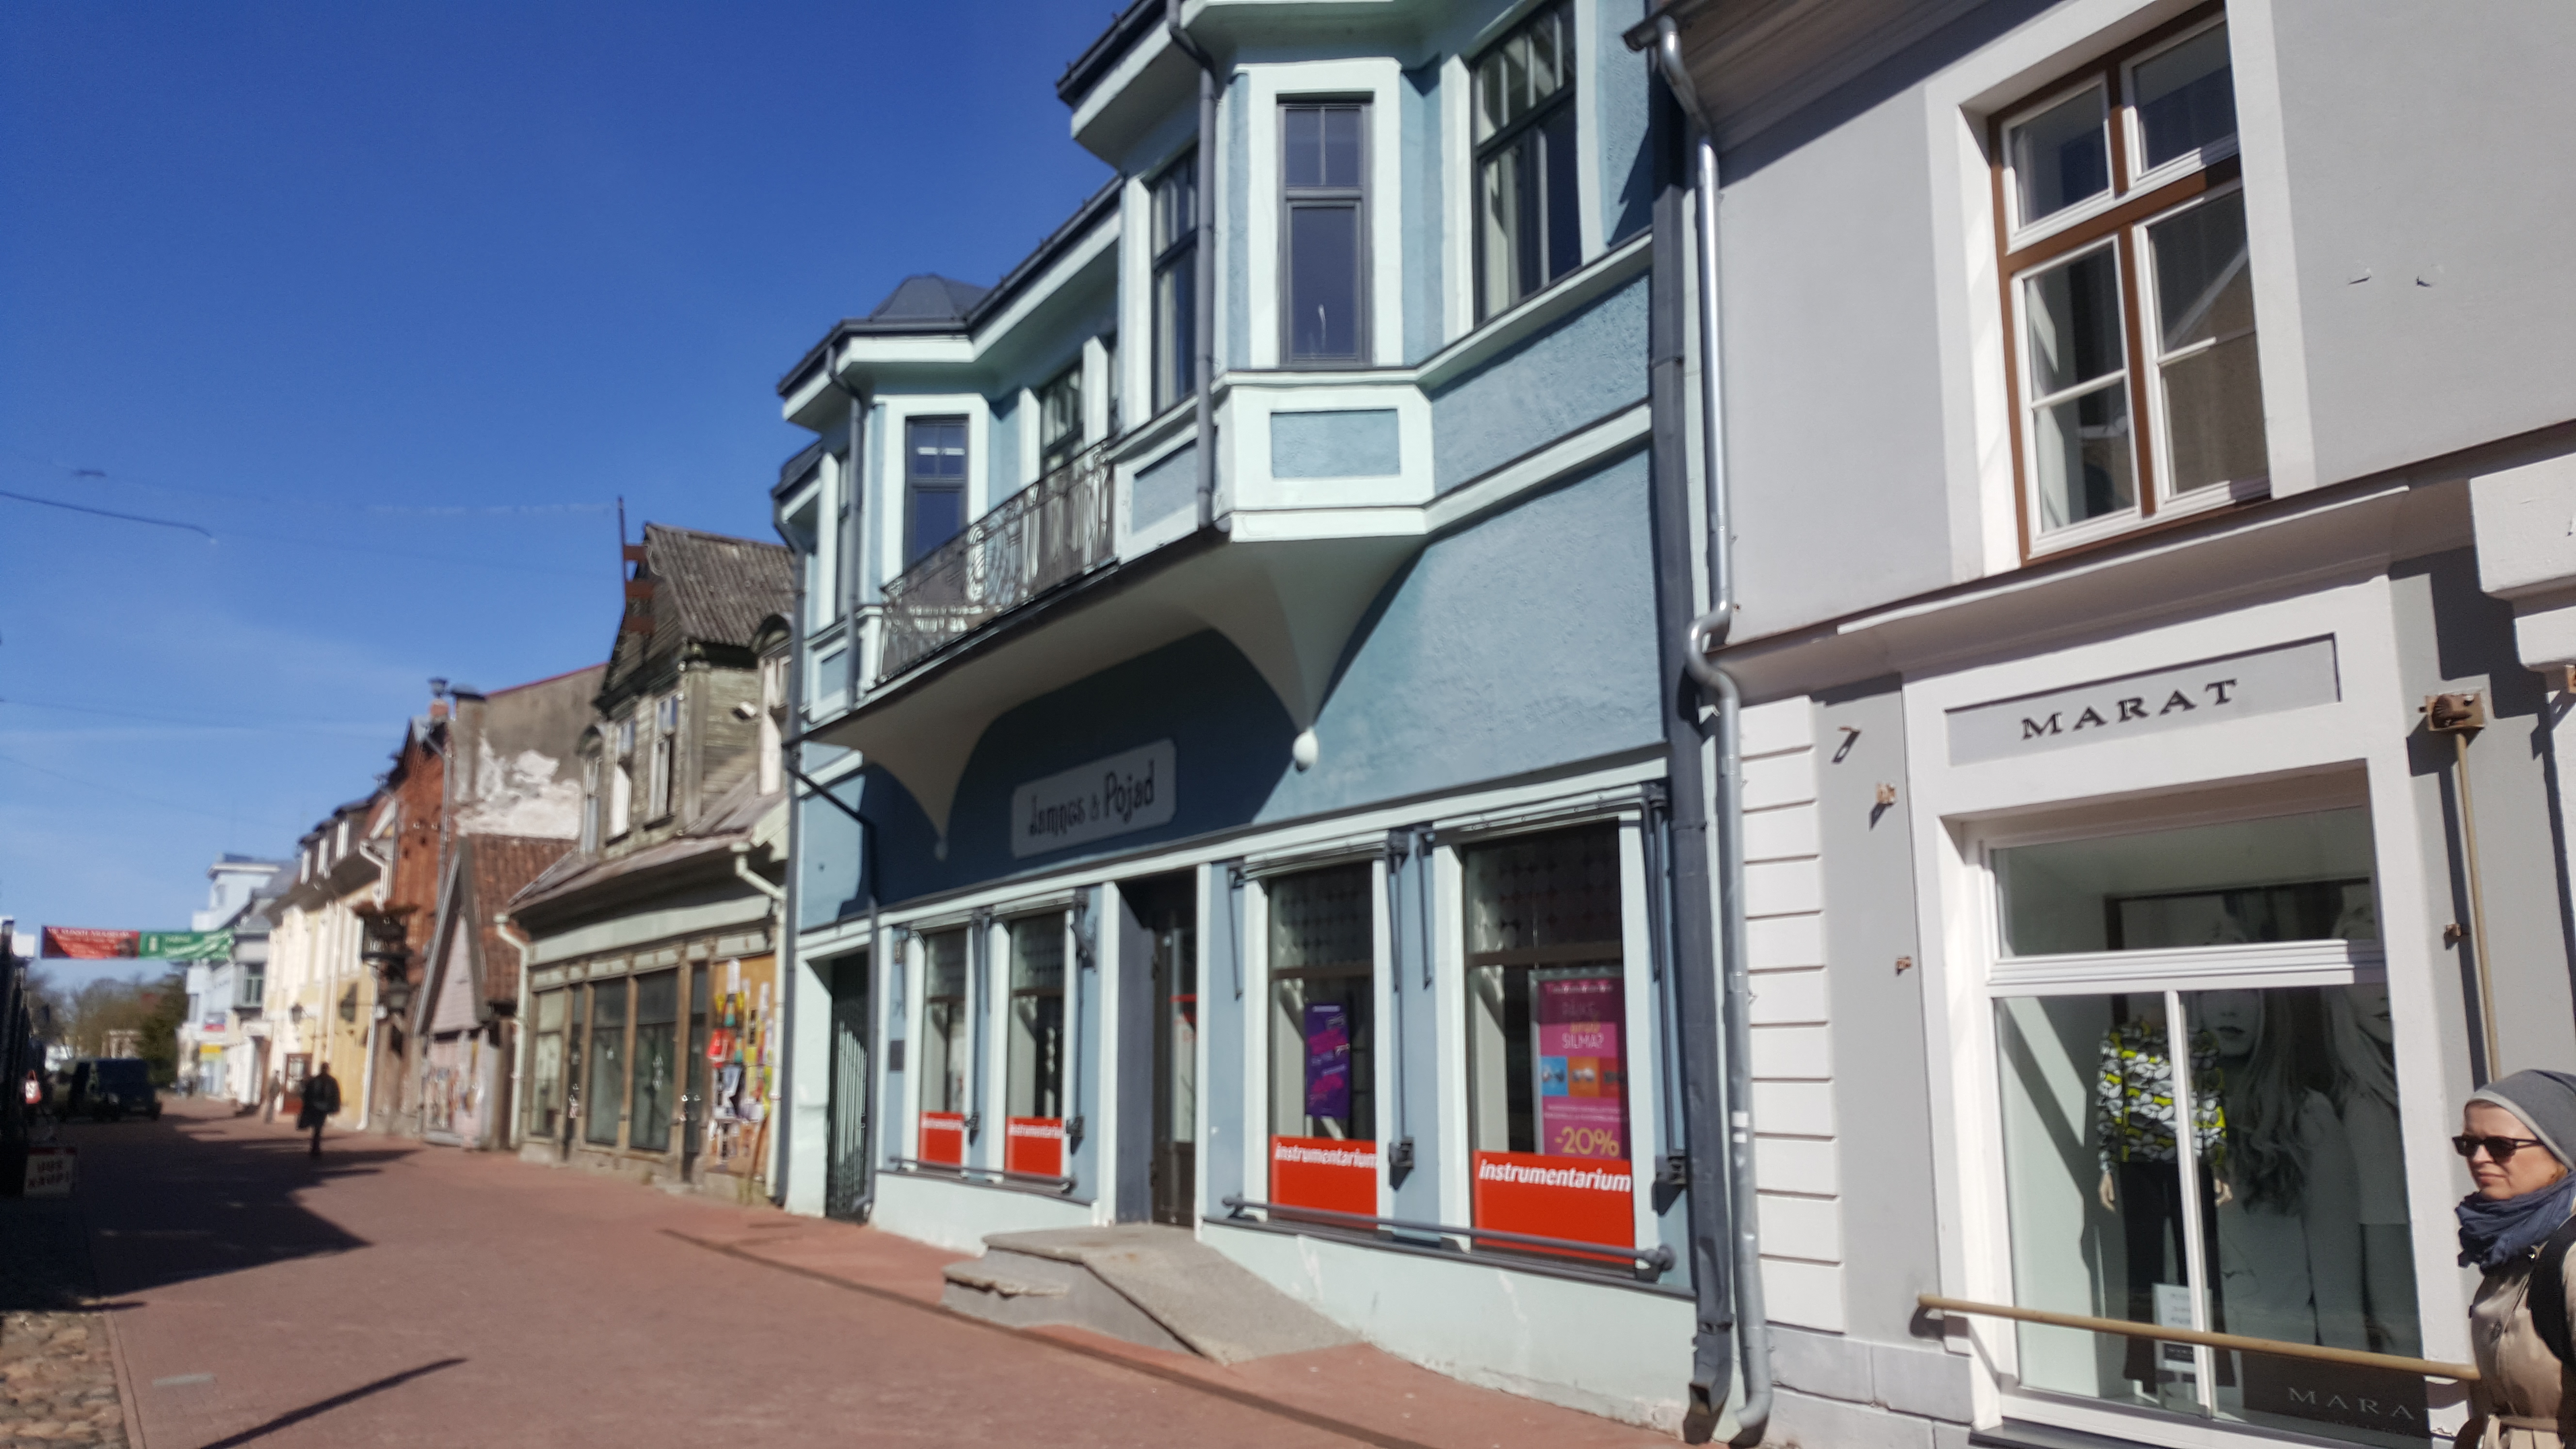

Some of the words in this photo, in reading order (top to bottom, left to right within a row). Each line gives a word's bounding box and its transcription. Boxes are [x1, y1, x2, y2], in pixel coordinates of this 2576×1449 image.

[2021, 678, 2238, 741] MARAT
[1104, 758, 1155, 824] Pojad
[1275, 1142, 1377, 1168] instrumentarium
[1554, 1126, 1620, 1158] -20%
[1479, 1159, 1631, 1192] instrumentarium
[2288, 1387, 2427, 1421] MARA
